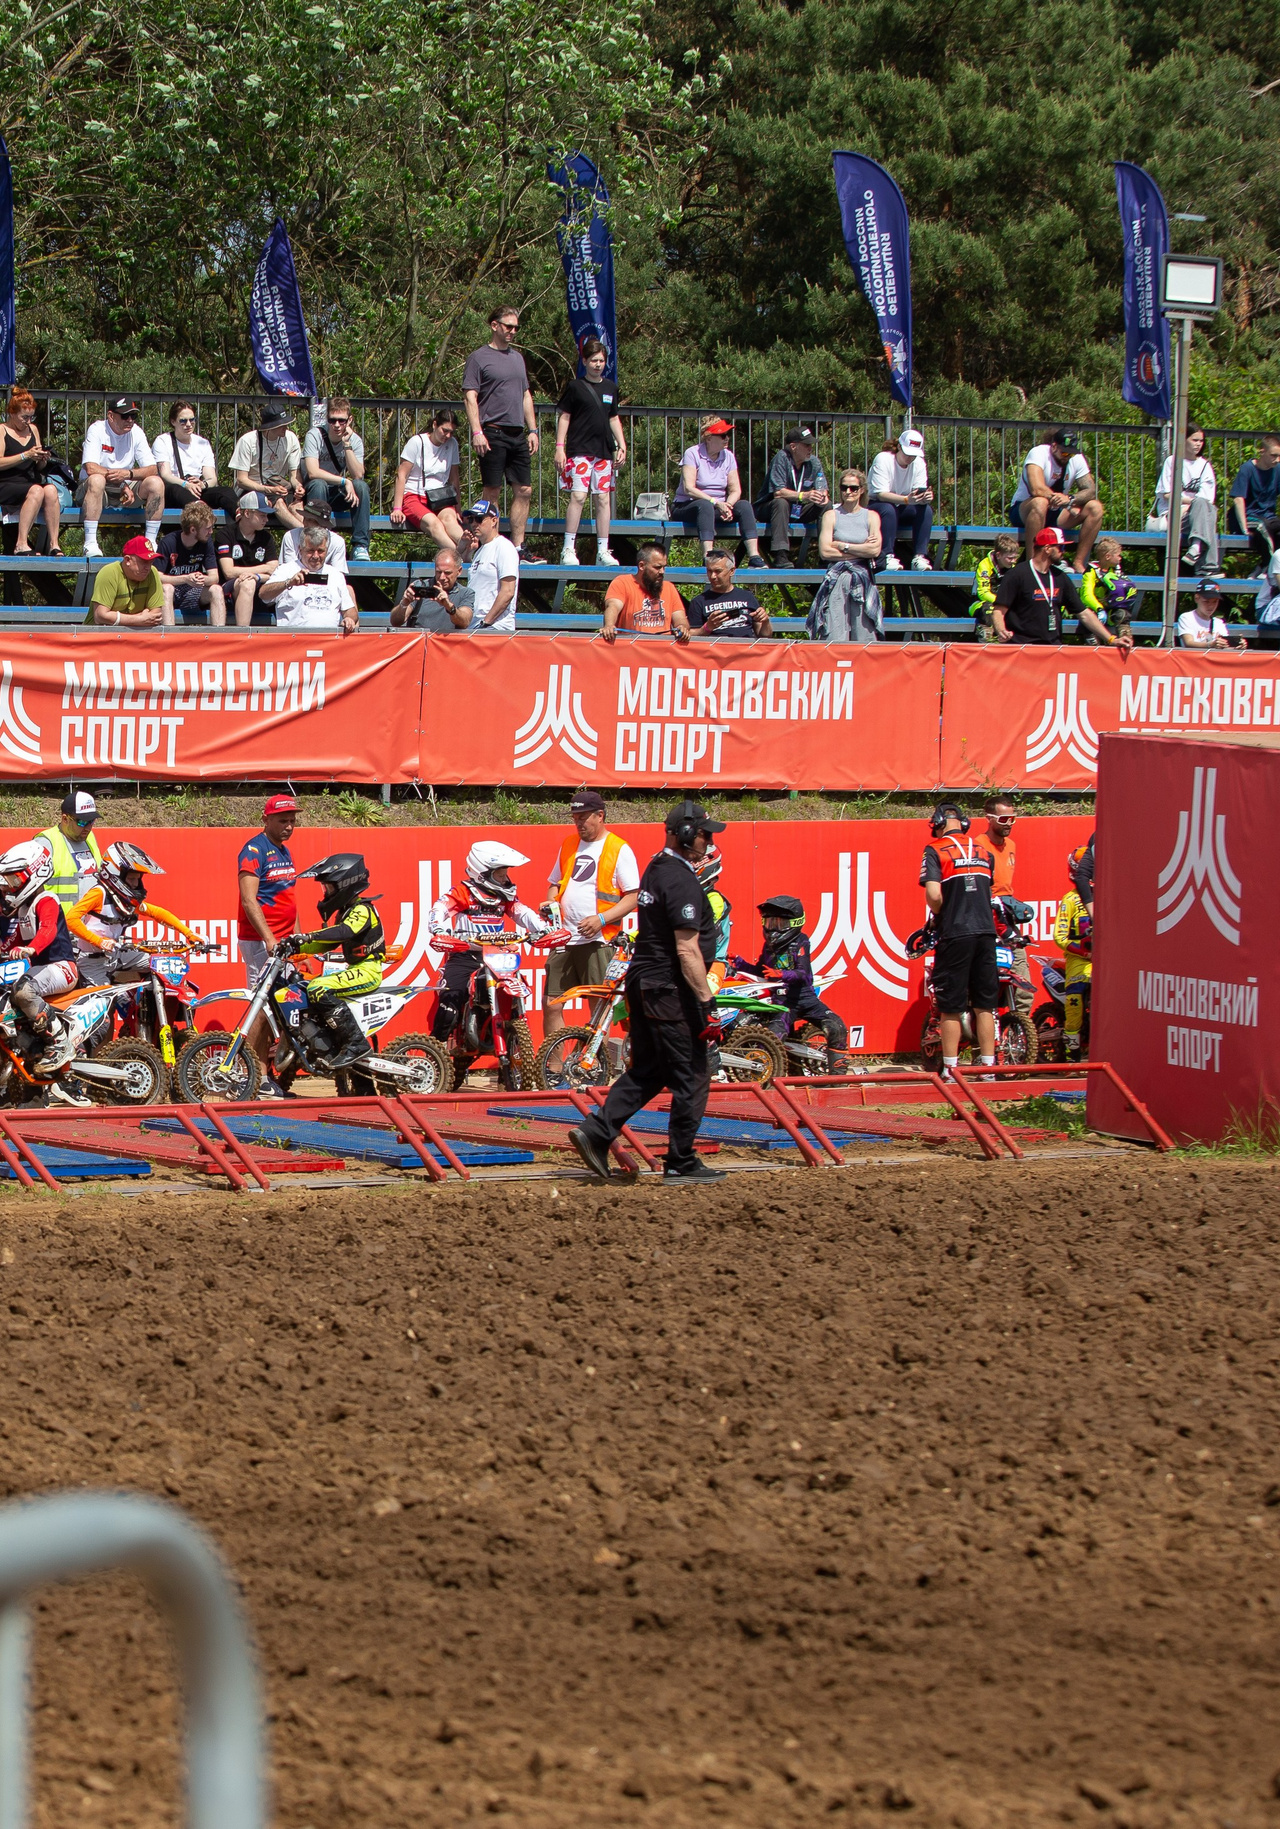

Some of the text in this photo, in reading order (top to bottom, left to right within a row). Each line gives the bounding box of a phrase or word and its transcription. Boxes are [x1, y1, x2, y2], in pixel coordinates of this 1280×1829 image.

[705, 601, 748, 613] LEGENDARY
[61, 650, 326, 712] МОСКОВСКИЙ
[617, 660, 854, 720] МОСКОВСКИЙ
[60, 715, 184, 768] СПОРТ
[614, 721, 730, 773] СПОРТ
[29, 854, 49, 875] ZERO
[337, 873, 368, 890] 100%
[336, 968, 363, 983] FOX
[1138, 970, 1258, 1027] МОСКОВСКИЙ
[851, 1027, 862, 1047] 7
[1167, 1025, 1223, 1073] СПОРТ
